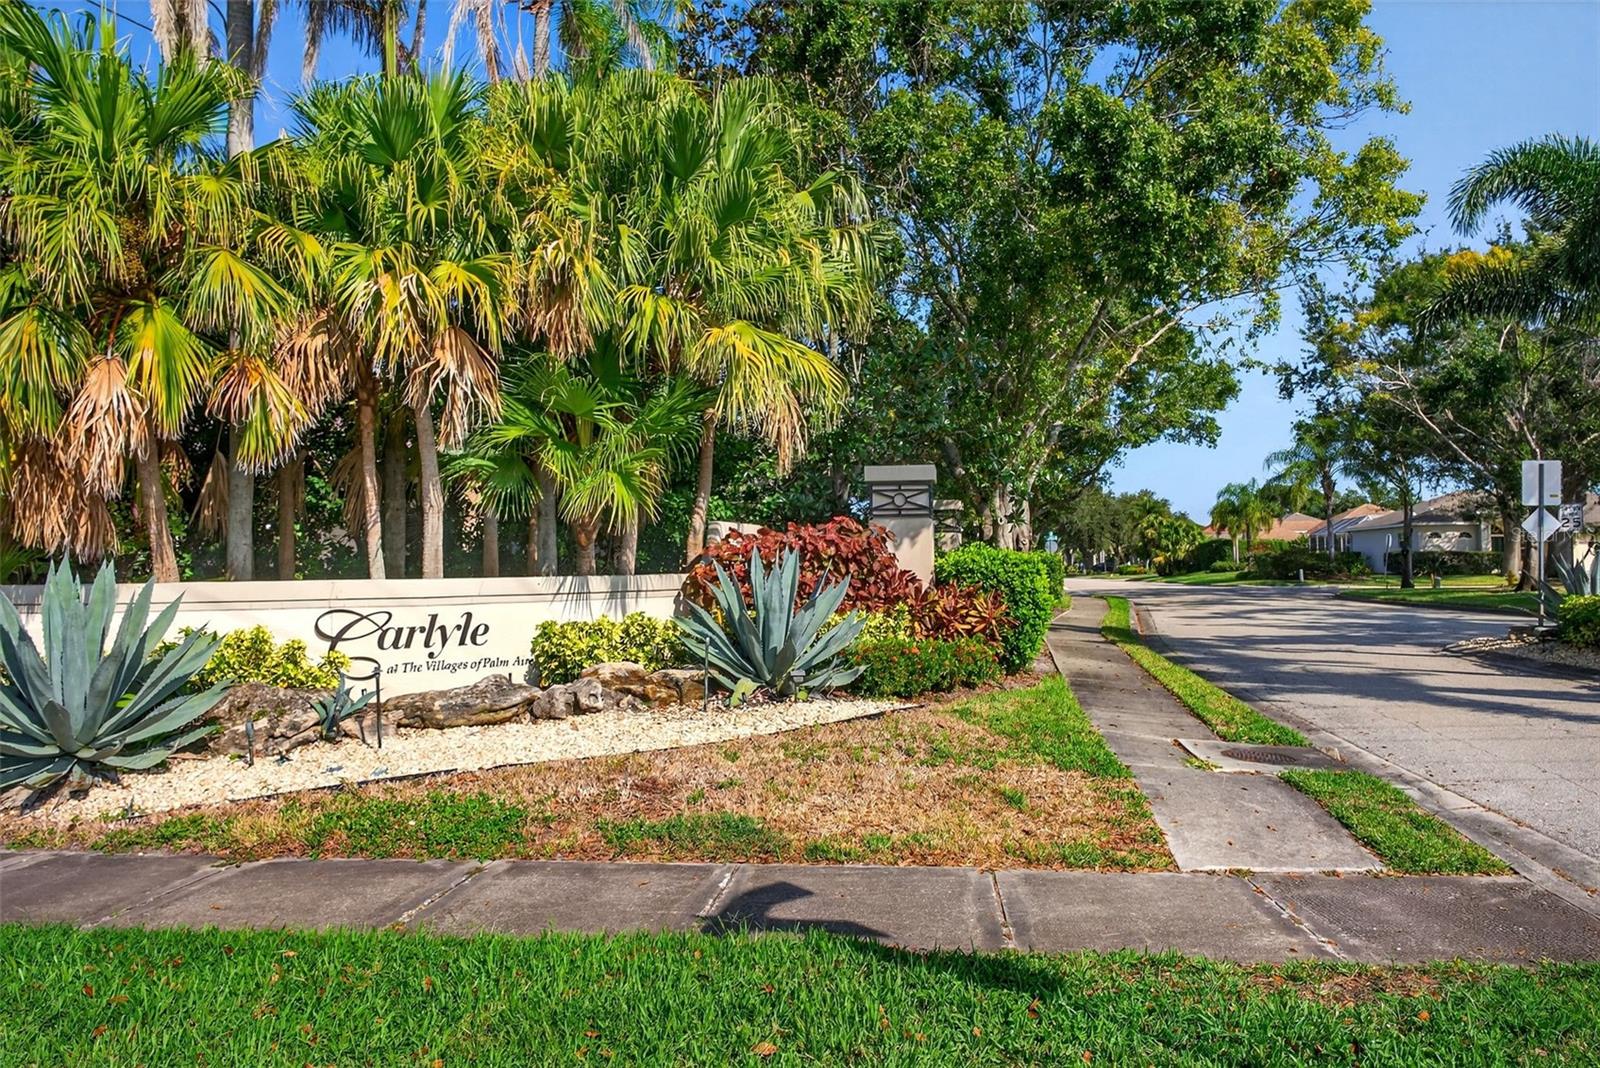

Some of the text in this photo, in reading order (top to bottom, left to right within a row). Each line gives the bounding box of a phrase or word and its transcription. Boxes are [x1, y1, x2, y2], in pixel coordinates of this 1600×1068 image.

[1561, 517, 1581, 528] 25
[402, 661, 423, 674] The
[426, 659, 468, 673] Villages
[470, 658, 484, 671] of
[483, 657, 509, 668] Palm
